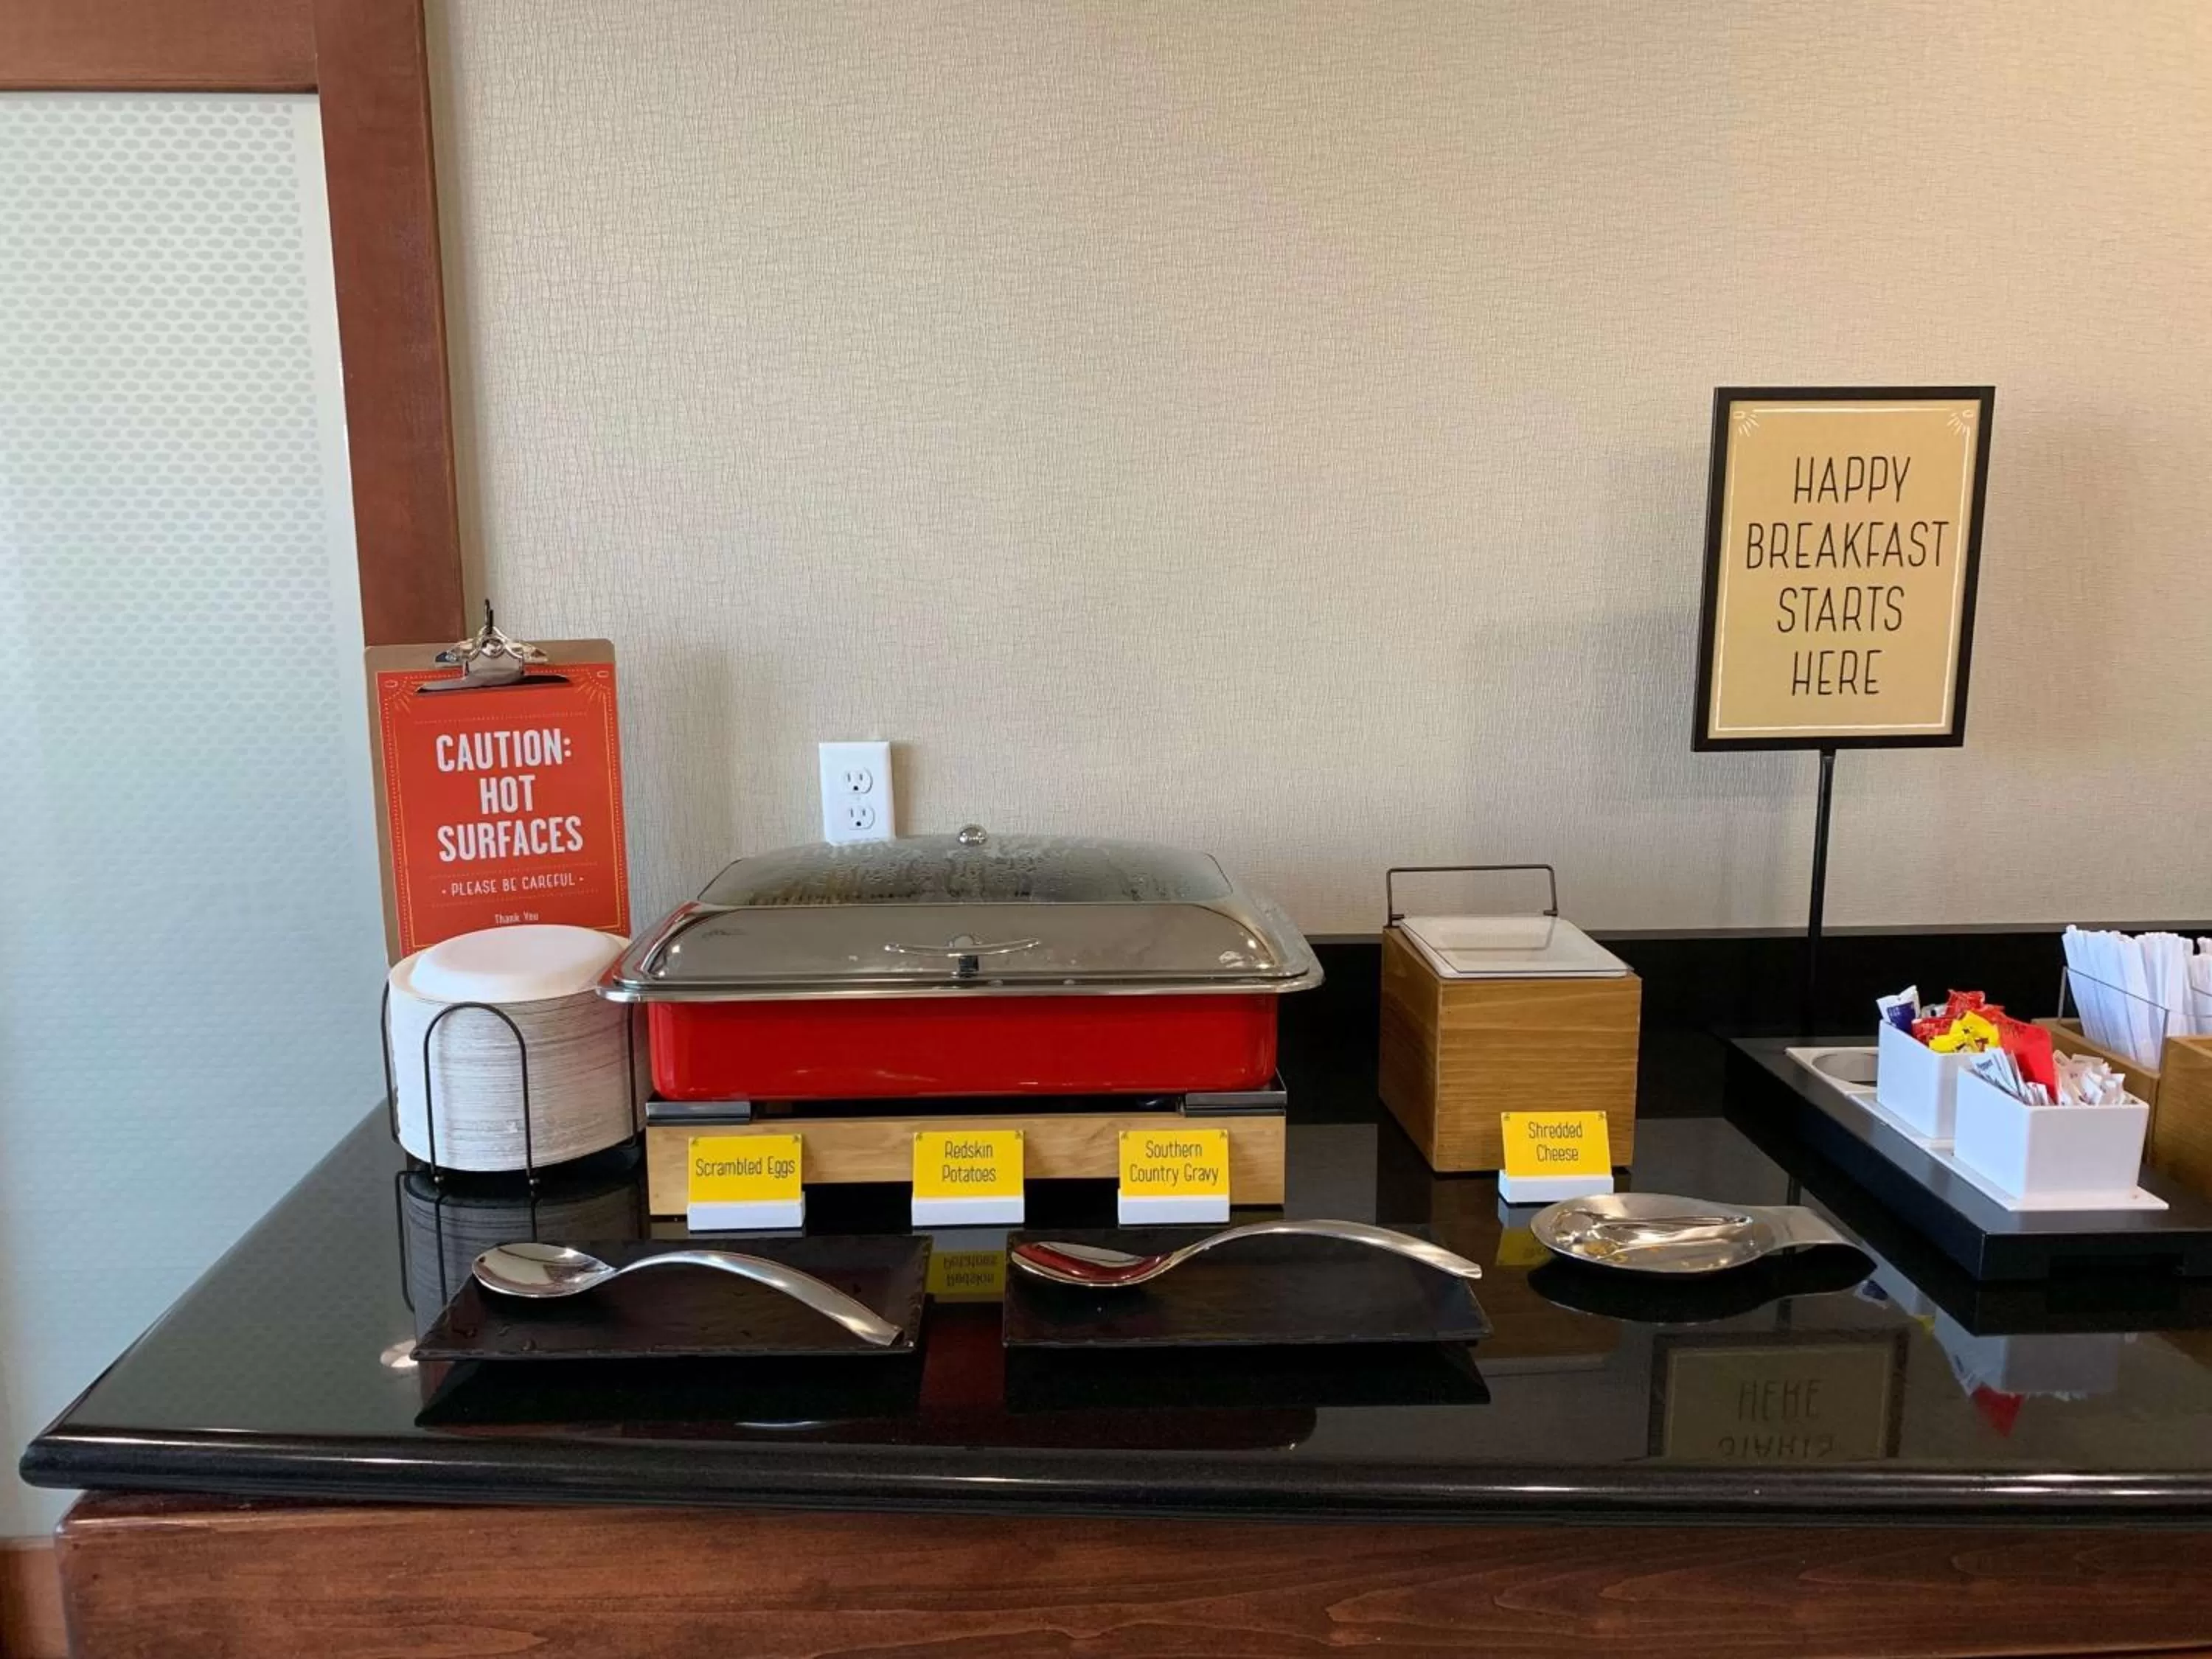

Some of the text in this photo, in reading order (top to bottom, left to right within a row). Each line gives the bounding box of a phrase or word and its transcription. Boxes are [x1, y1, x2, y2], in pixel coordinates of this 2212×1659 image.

[1793, 456, 1911, 504] HAPPY
[1746, 521, 1950, 568] BREAKFAST
[1777, 585, 1905, 633] STARTS
[1792, 649, 1882, 696] HERE
[436, 728, 571, 772] CAUTION:
[479, 774, 536, 815] HOT
[437, 815, 583, 862] SURFACES
[451, 873, 576, 897] PLEASE BE CAREFUL
[495, 911, 539, 924] Thank You
[1528, 1121, 1583, 1139] Shredded
[945, 1141, 993, 1158] Redskin
[1145, 1139, 1203, 1158] Southern
[1536, 1144, 1579, 1162] Cheese
[695, 1155, 796, 1179] Scrambled Eggs
[942, 1164, 997, 1182] Potatoes
[1130, 1163, 1219, 1186] Country Gravy
